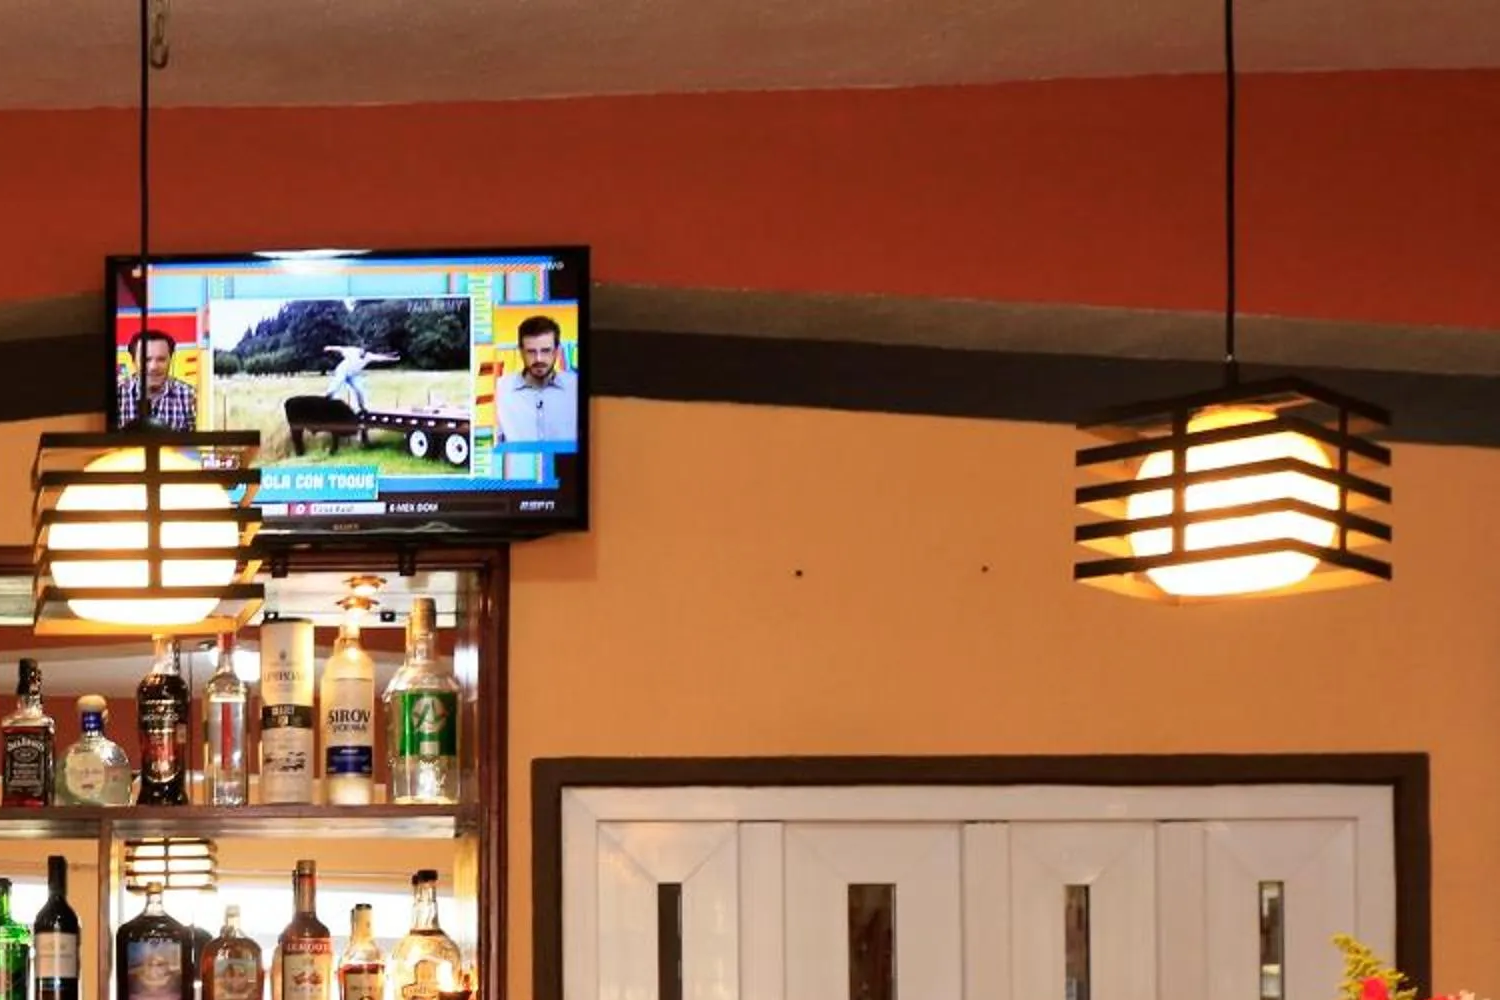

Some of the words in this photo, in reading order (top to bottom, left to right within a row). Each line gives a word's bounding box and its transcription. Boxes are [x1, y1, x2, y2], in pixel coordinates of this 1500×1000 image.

[295, 474, 324, 489] CON
[328, 473, 375, 489] TOQUE
[328, 708, 371, 723] SIROV
